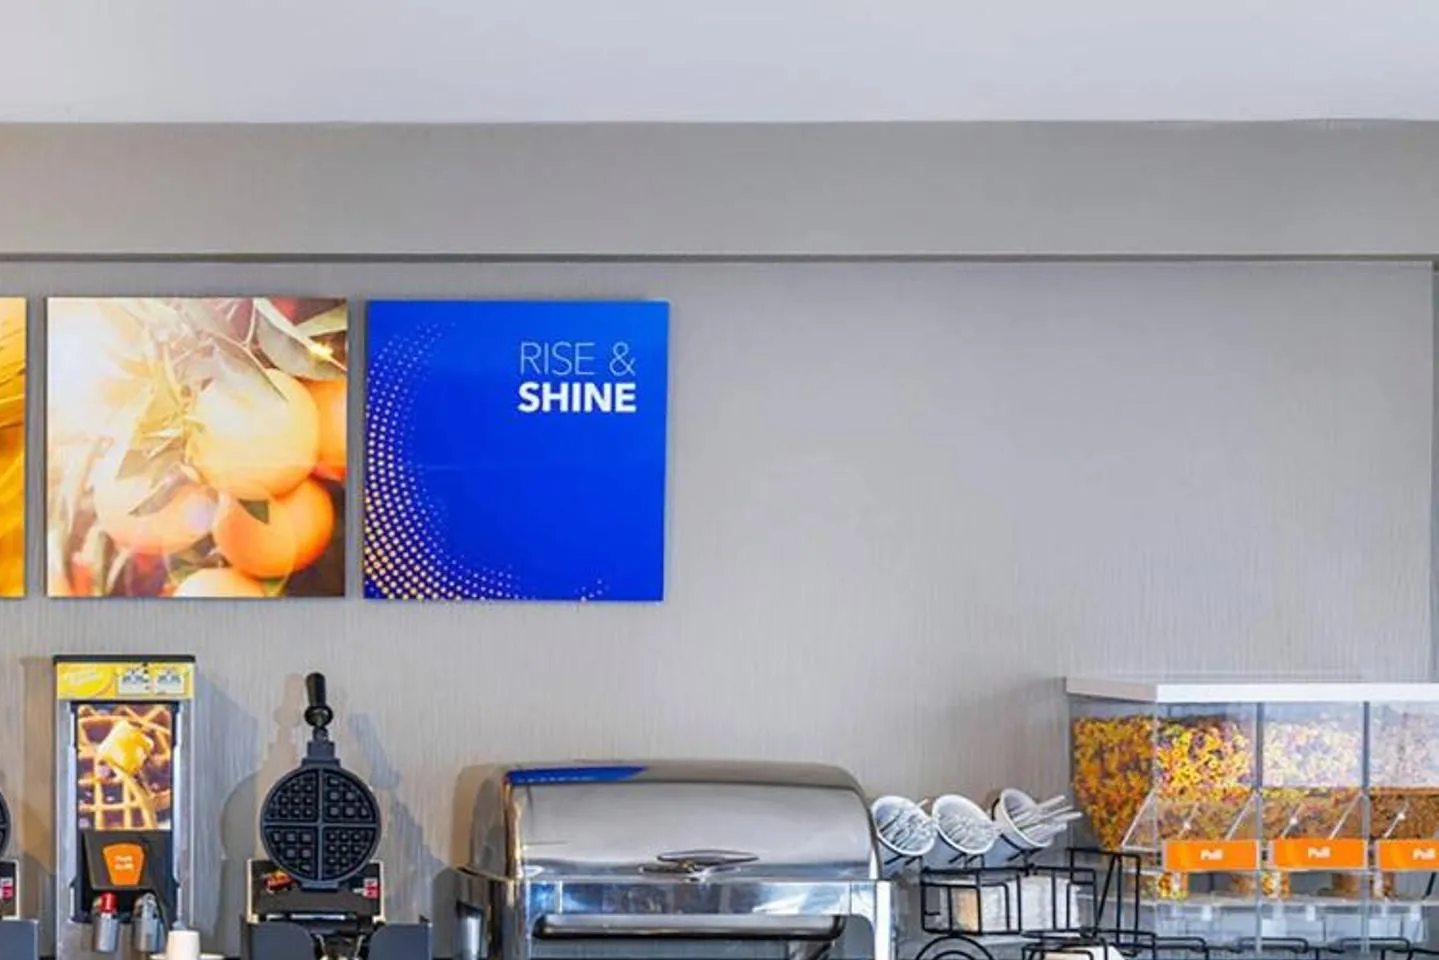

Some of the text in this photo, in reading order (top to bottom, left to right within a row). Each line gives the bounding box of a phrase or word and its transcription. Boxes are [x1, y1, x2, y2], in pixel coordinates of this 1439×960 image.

[520, 341, 637, 377] RISE &
[518, 381, 637, 413] SHINE
